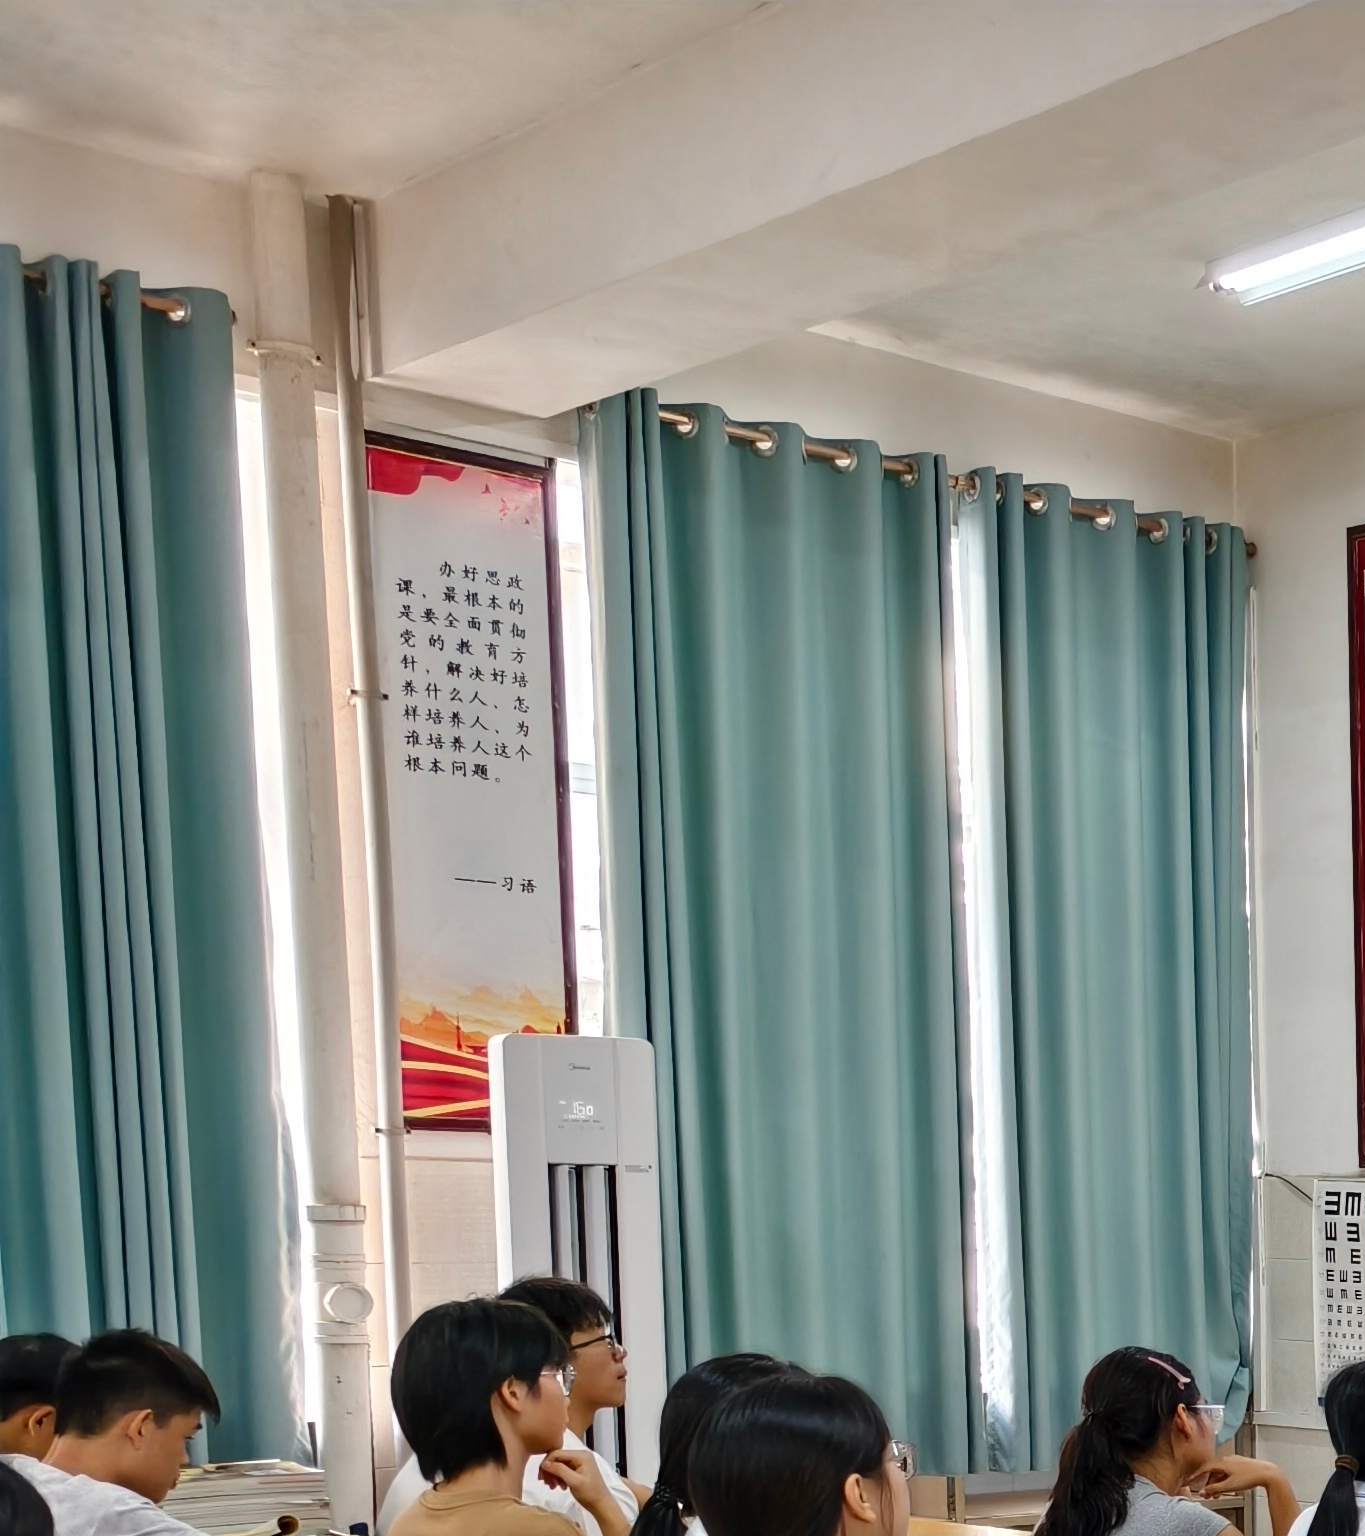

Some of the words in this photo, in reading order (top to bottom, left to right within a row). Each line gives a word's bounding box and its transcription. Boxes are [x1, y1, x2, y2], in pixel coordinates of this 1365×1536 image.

[440, 561, 524, 590] 办好思政
[398, 605, 525, 640] 是要全面贯彻
[400, 629, 526, 663] 党的教育方
[405, 729, 532, 763] 谁培养人这个
[404, 754, 502, 784] 根本问题。
